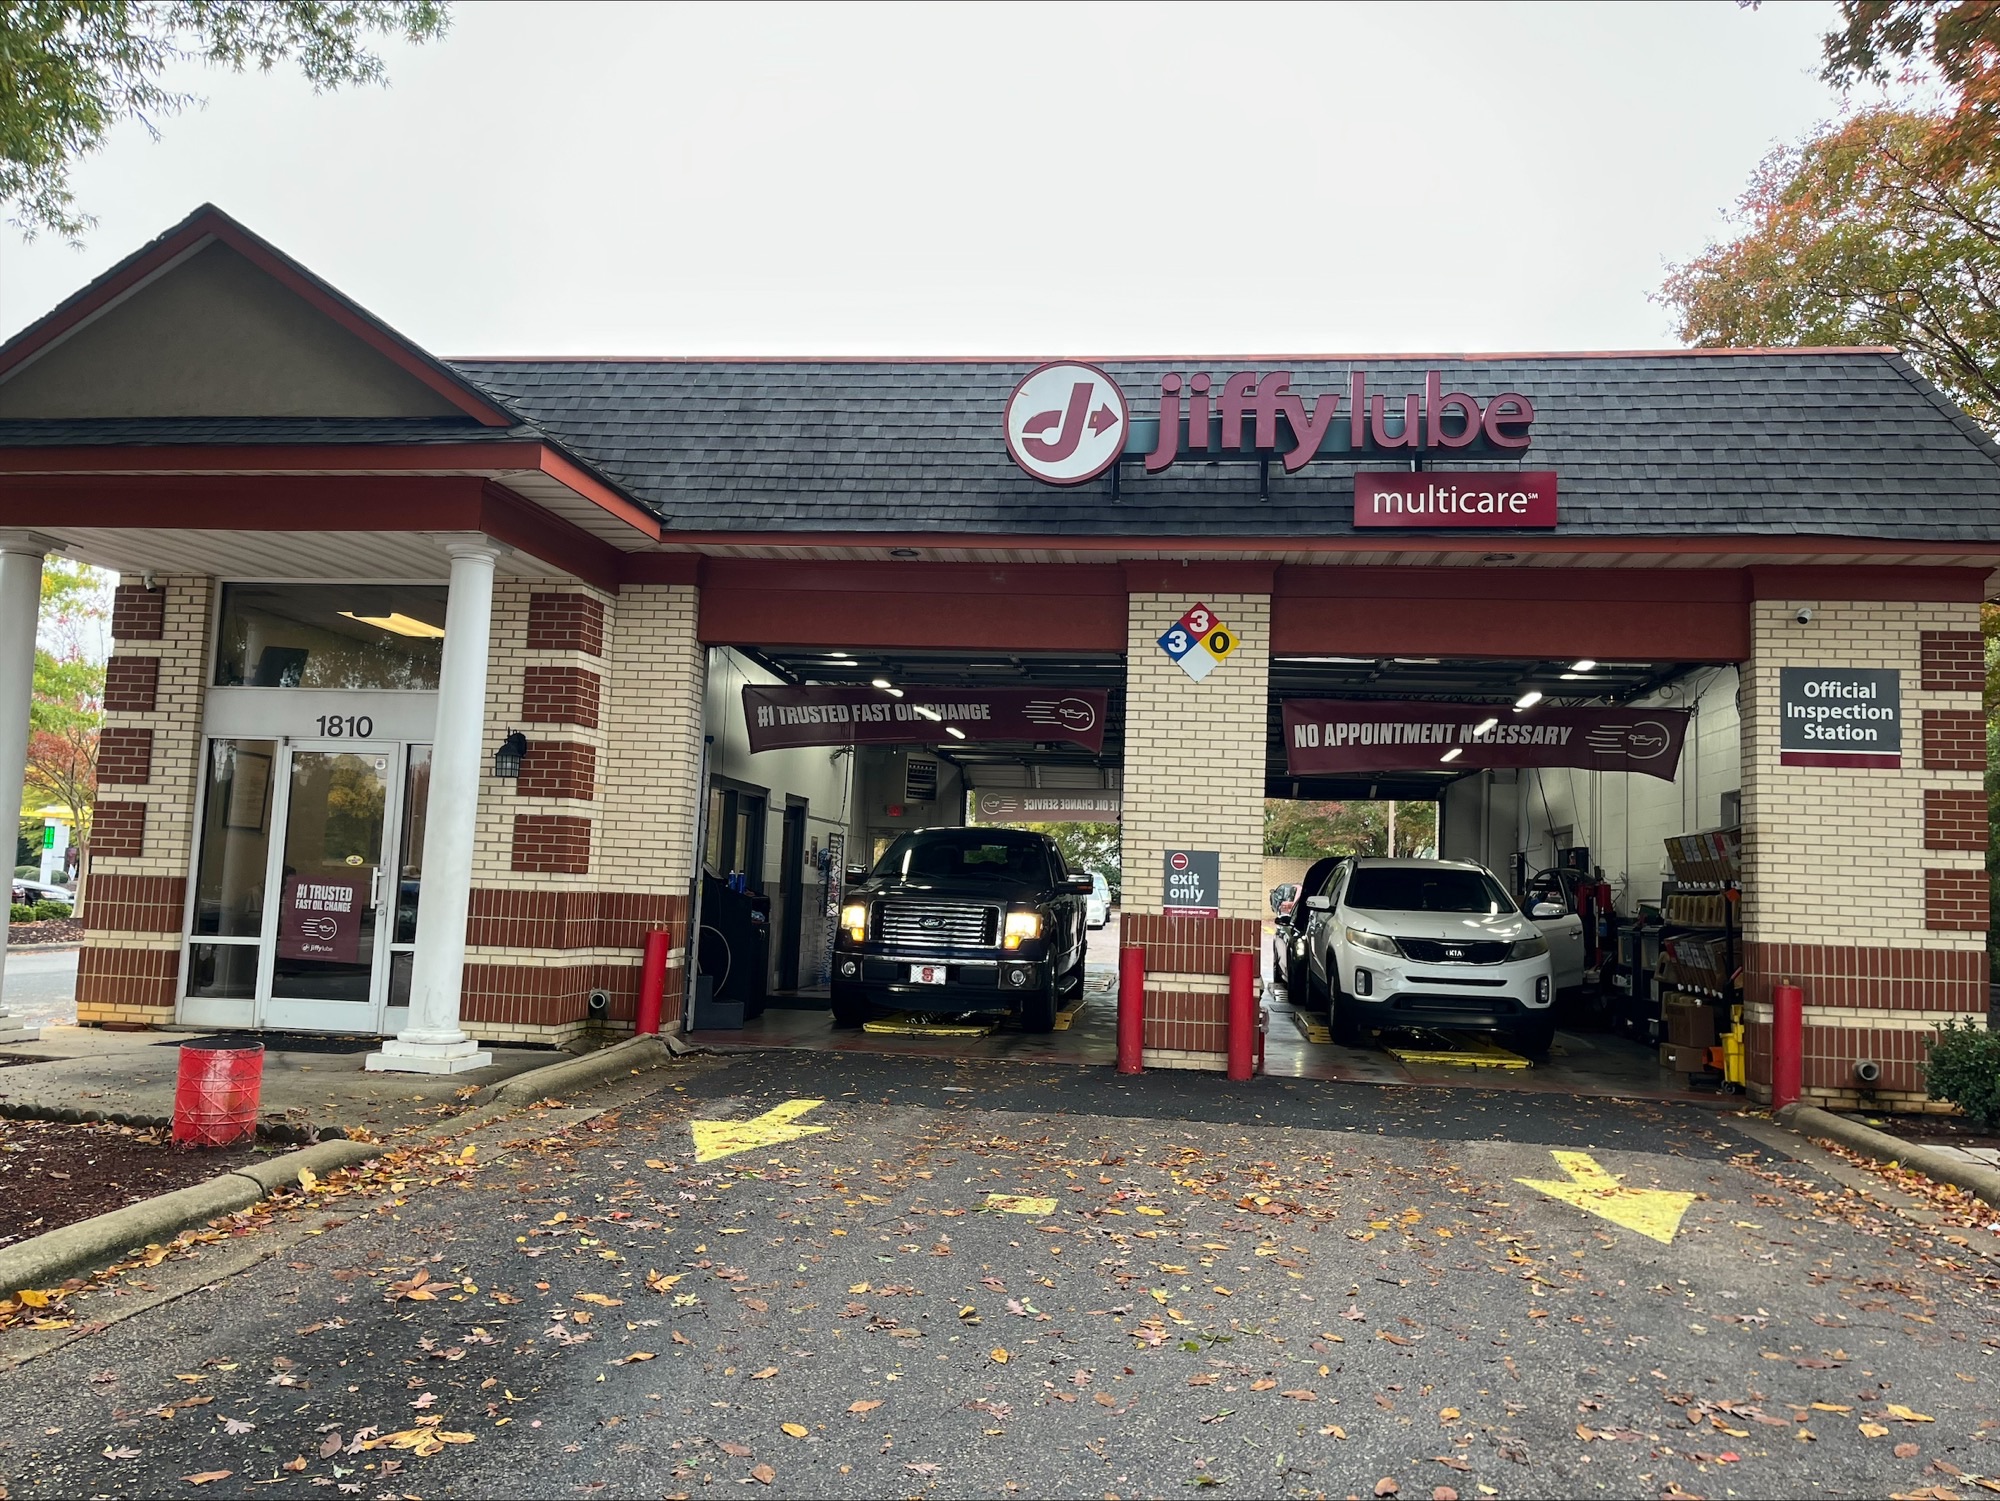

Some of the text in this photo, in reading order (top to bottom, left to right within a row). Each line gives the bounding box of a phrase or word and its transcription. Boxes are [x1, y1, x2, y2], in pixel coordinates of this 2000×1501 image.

[1144, 370, 1534, 474] jiffy lube
[1189, 609, 1209, 633] 3
[1167, 630, 1230, 654] 3 0
[1803, 681, 1877, 699] Official
[757, 705, 775, 727] #1
[777, 704, 850, 725] TRUSTED
[851, 703, 891, 722] FAST
[894, 703, 921, 721] OIL
[1787, 702, 1894, 722] Inspection
[316, 715, 373, 738] 1810
[1294, 723, 1319, 748] NO
[1324, 722, 1455, 747] APPOINTMENT
[1803, 723, 1878, 741] Station
[1170, 871, 1199, 885] exit
[296, 883, 353, 902] #1 TRUSTED
[1170, 885, 1204, 902] only
[295, 899, 352, 913] FAST OIL CHANGE
